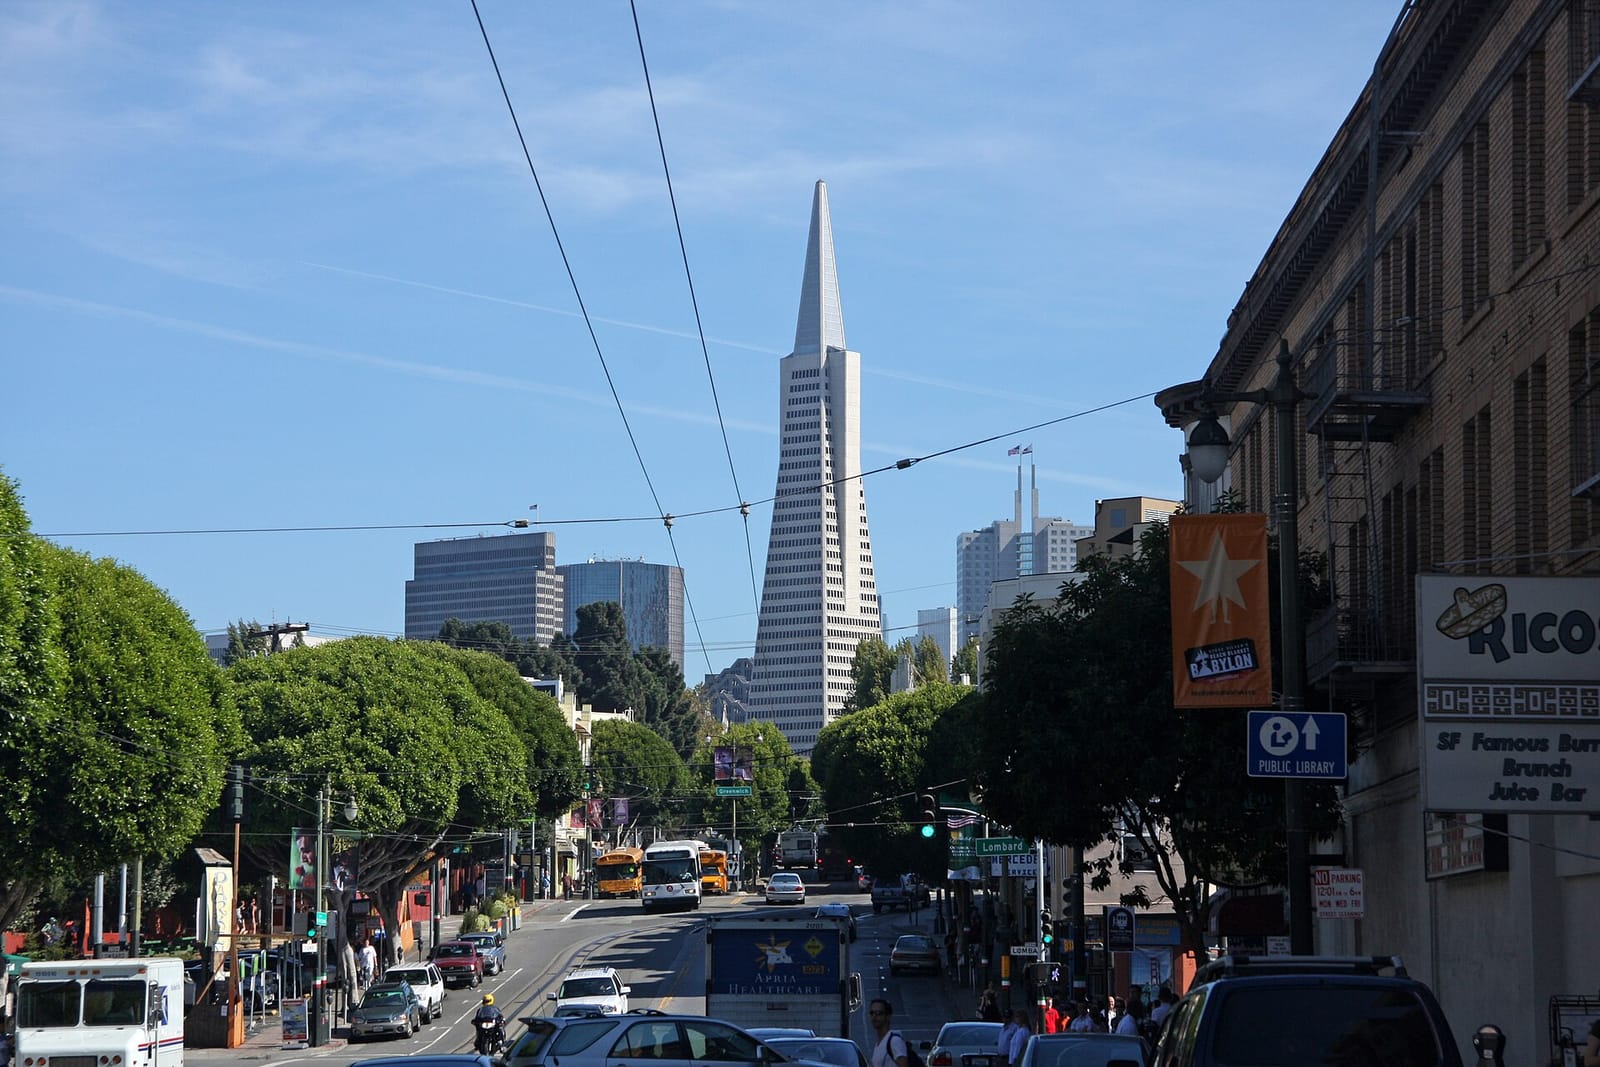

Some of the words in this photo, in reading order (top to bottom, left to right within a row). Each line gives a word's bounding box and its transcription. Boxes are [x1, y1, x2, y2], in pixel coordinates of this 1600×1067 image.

[1468, 609, 1600, 664] RICO
[1436, 731, 1462, 751] SF
[1472, 732, 1550, 752] Famous
[1258, 759, 1291, 773] PUBLIC
[1296, 760, 1335, 775] LIBRARY
[1502, 758, 1573, 778] Brunch
[1488, 782, 1540, 803] Juice
[1550, 783, 1588, 802] Bar
[982, 841, 1024, 853] Lombard
[1315, 871, 1328, 884] NO
[1331, 873, 1361, 883] PARKING
[754, 972, 797, 984] APRIA
[728, 983, 822, 995] HEALTHCARE
